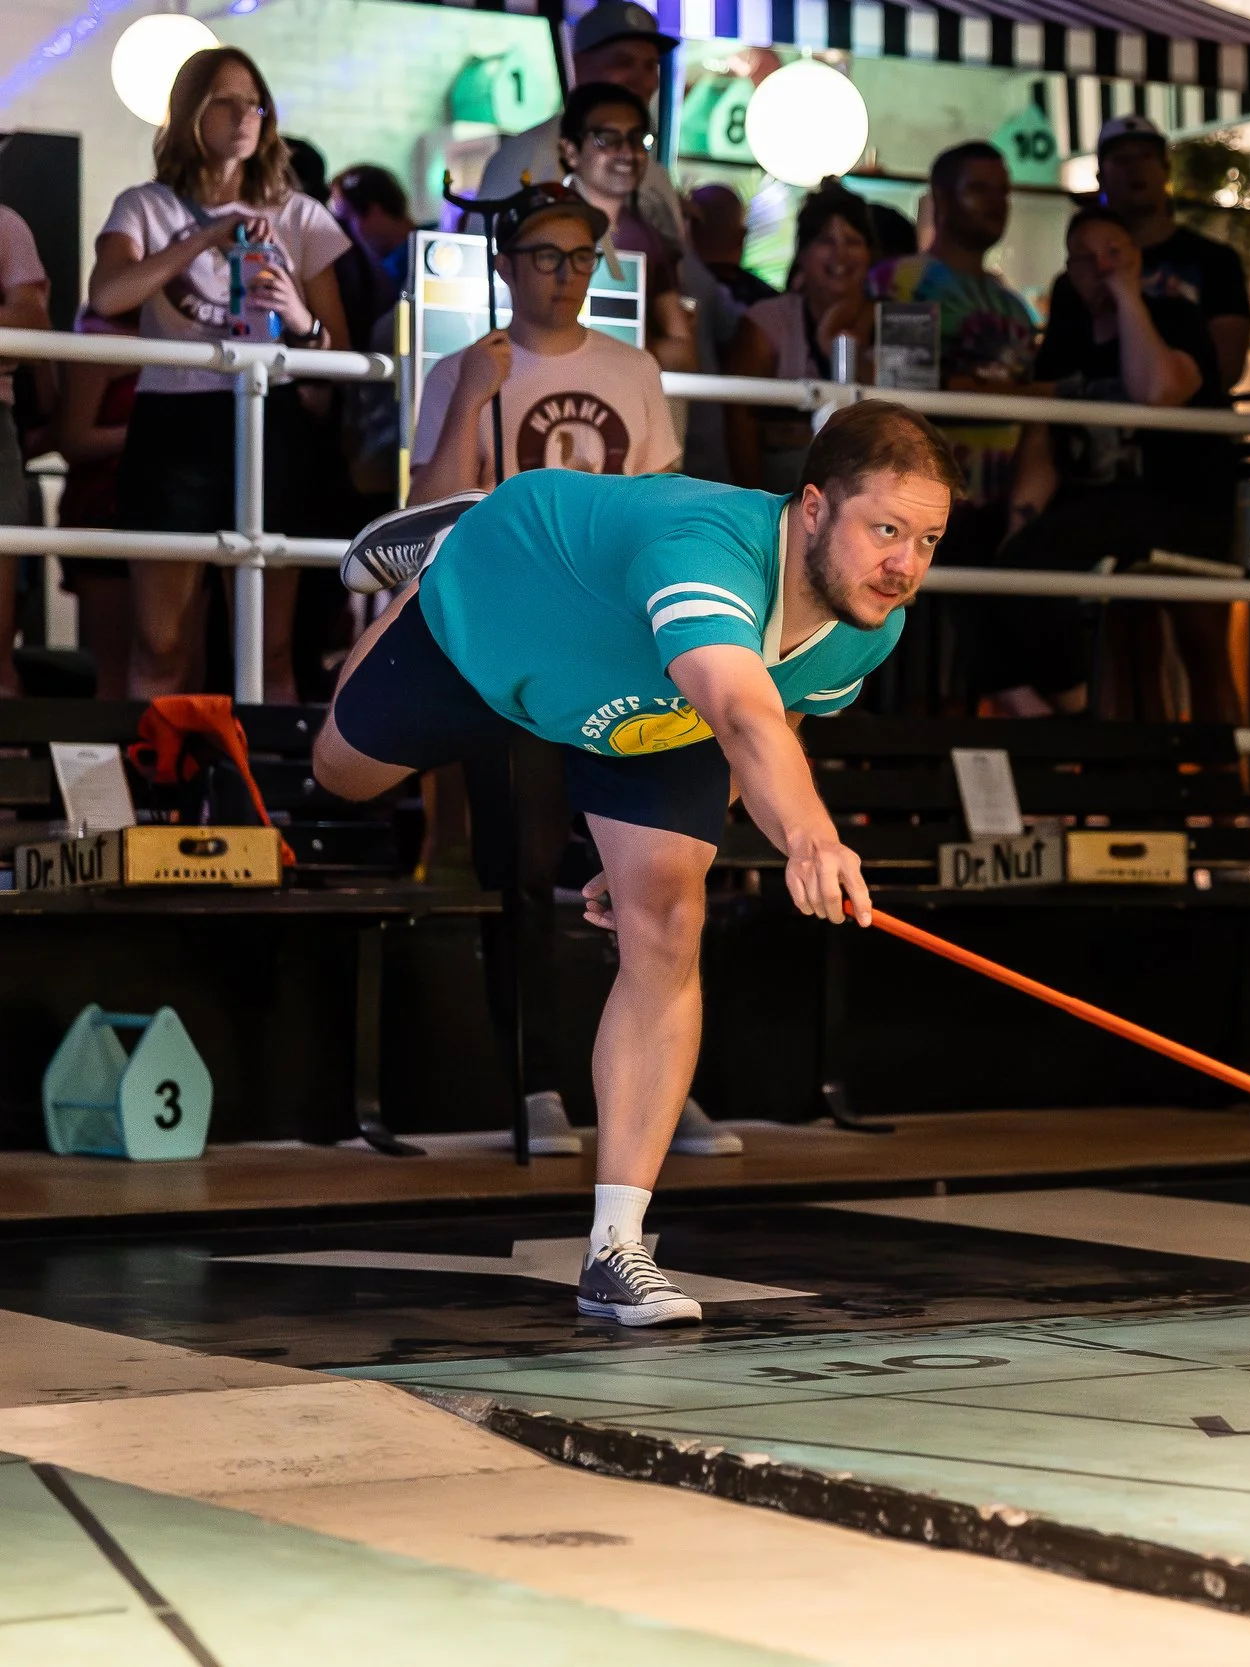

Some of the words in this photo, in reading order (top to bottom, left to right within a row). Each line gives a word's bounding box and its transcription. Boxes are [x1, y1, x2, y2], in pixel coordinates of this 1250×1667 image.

[511, 71, 524, 103] 1
[726, 106, 746, 144] 8
[1013, 131, 1056, 162] 10
[60, 835, 107, 887] Nut
[993, 841, 1045, 880] Nut
[155, 1080, 182, 1130] 3
[750, 1353, 1011, 1384] OFF
